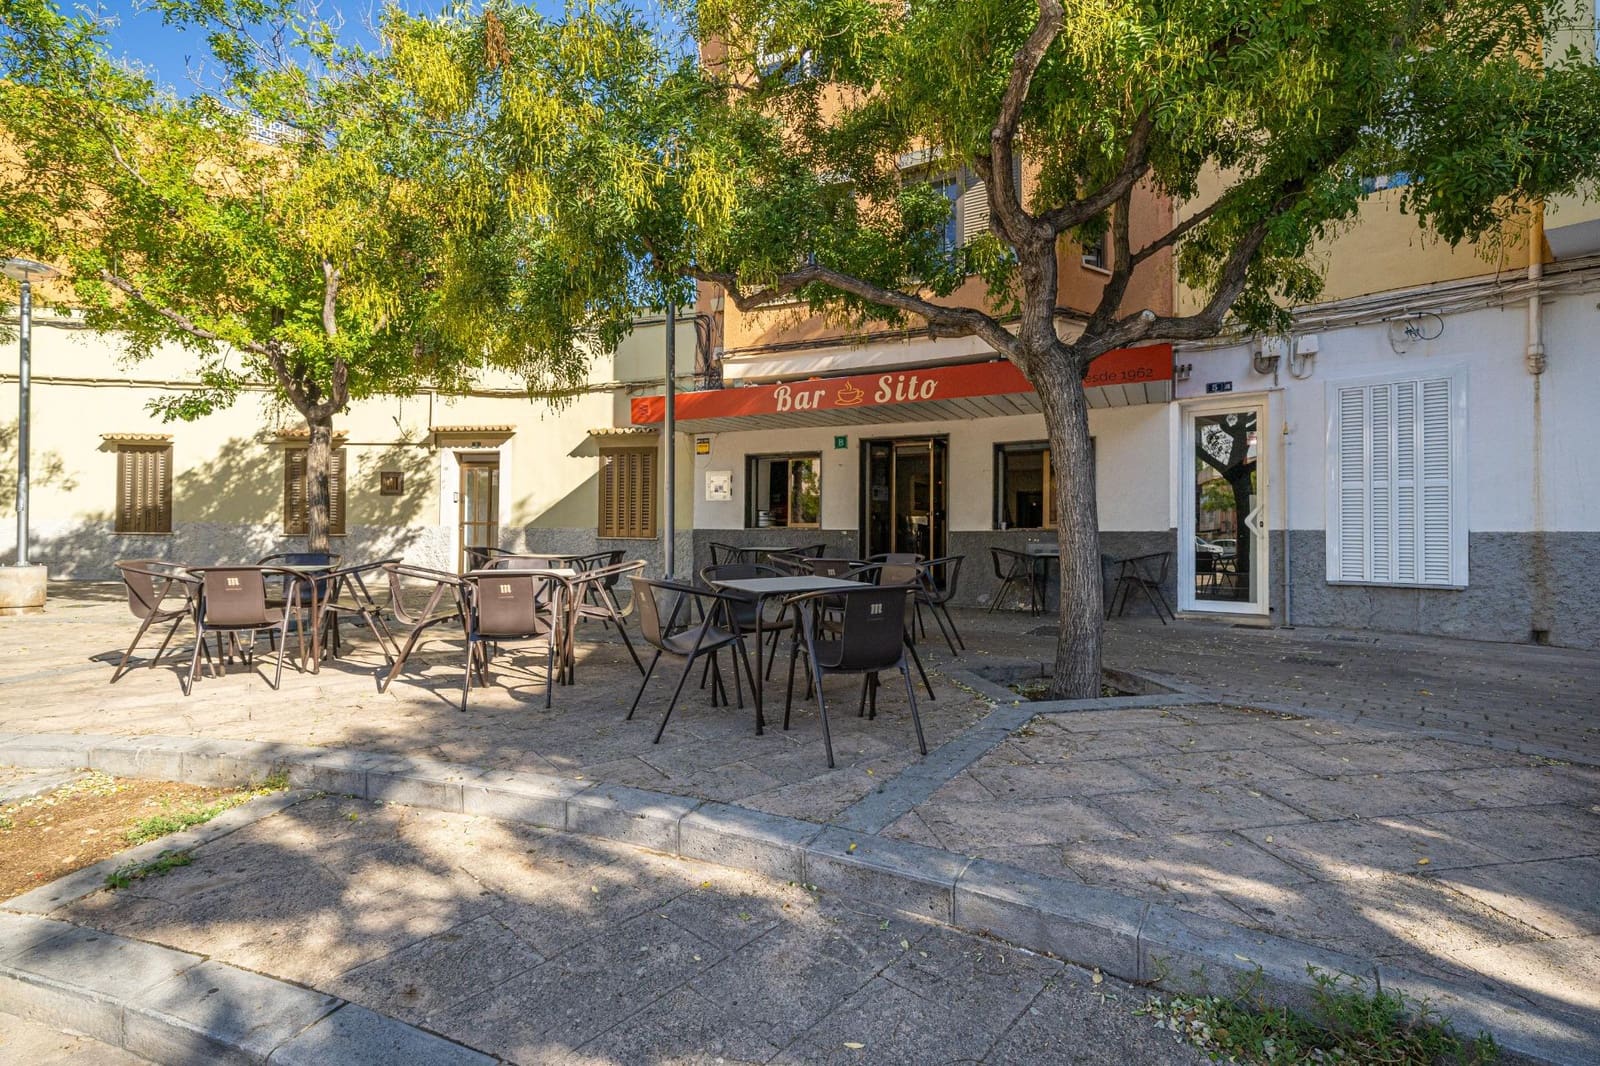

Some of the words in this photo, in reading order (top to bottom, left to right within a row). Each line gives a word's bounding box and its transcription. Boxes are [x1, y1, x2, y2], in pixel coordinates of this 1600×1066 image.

[1084, 371, 1117, 383] esde
[1122, 367, 1153, 381] 1962
[774, 386, 826, 412] Bar
[874, 375, 938, 403] Sito
